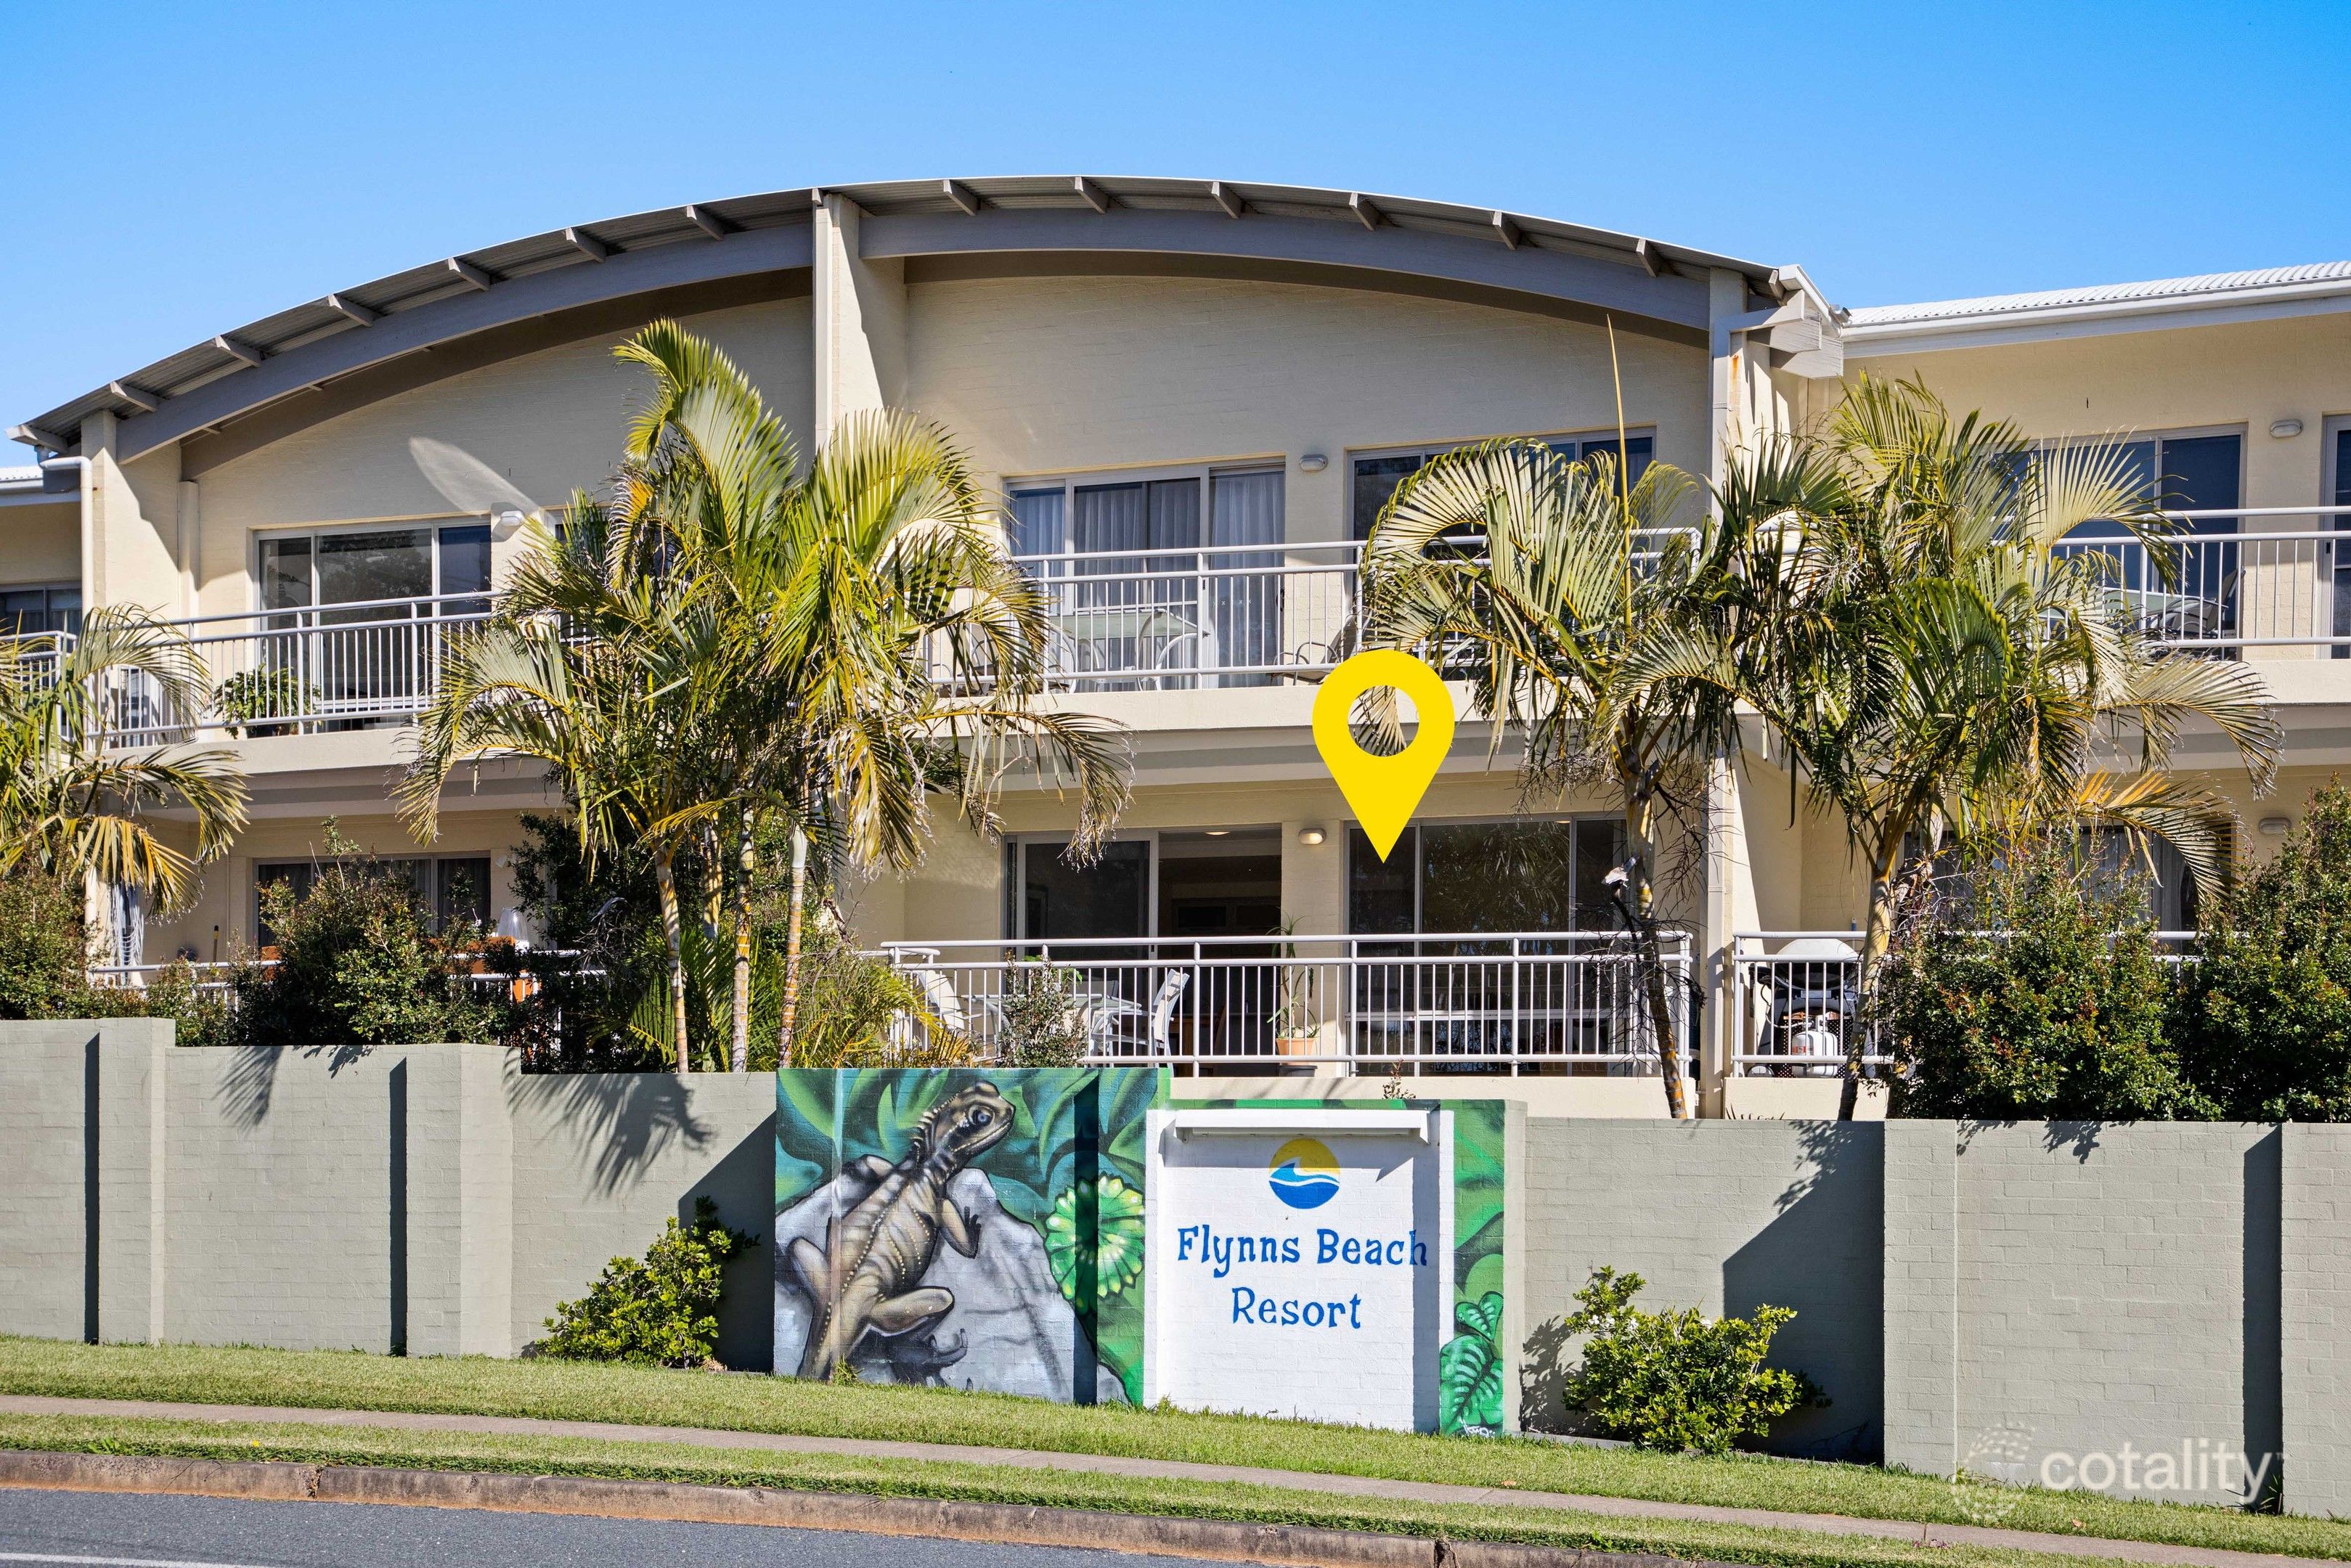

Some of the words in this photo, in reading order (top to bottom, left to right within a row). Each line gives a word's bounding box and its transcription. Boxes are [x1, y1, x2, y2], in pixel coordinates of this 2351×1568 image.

[1178, 1224, 1300, 1279] Flynns
[1316, 1228, 1428, 1267] Beach
[1231, 1286, 1361, 1331] Resort
